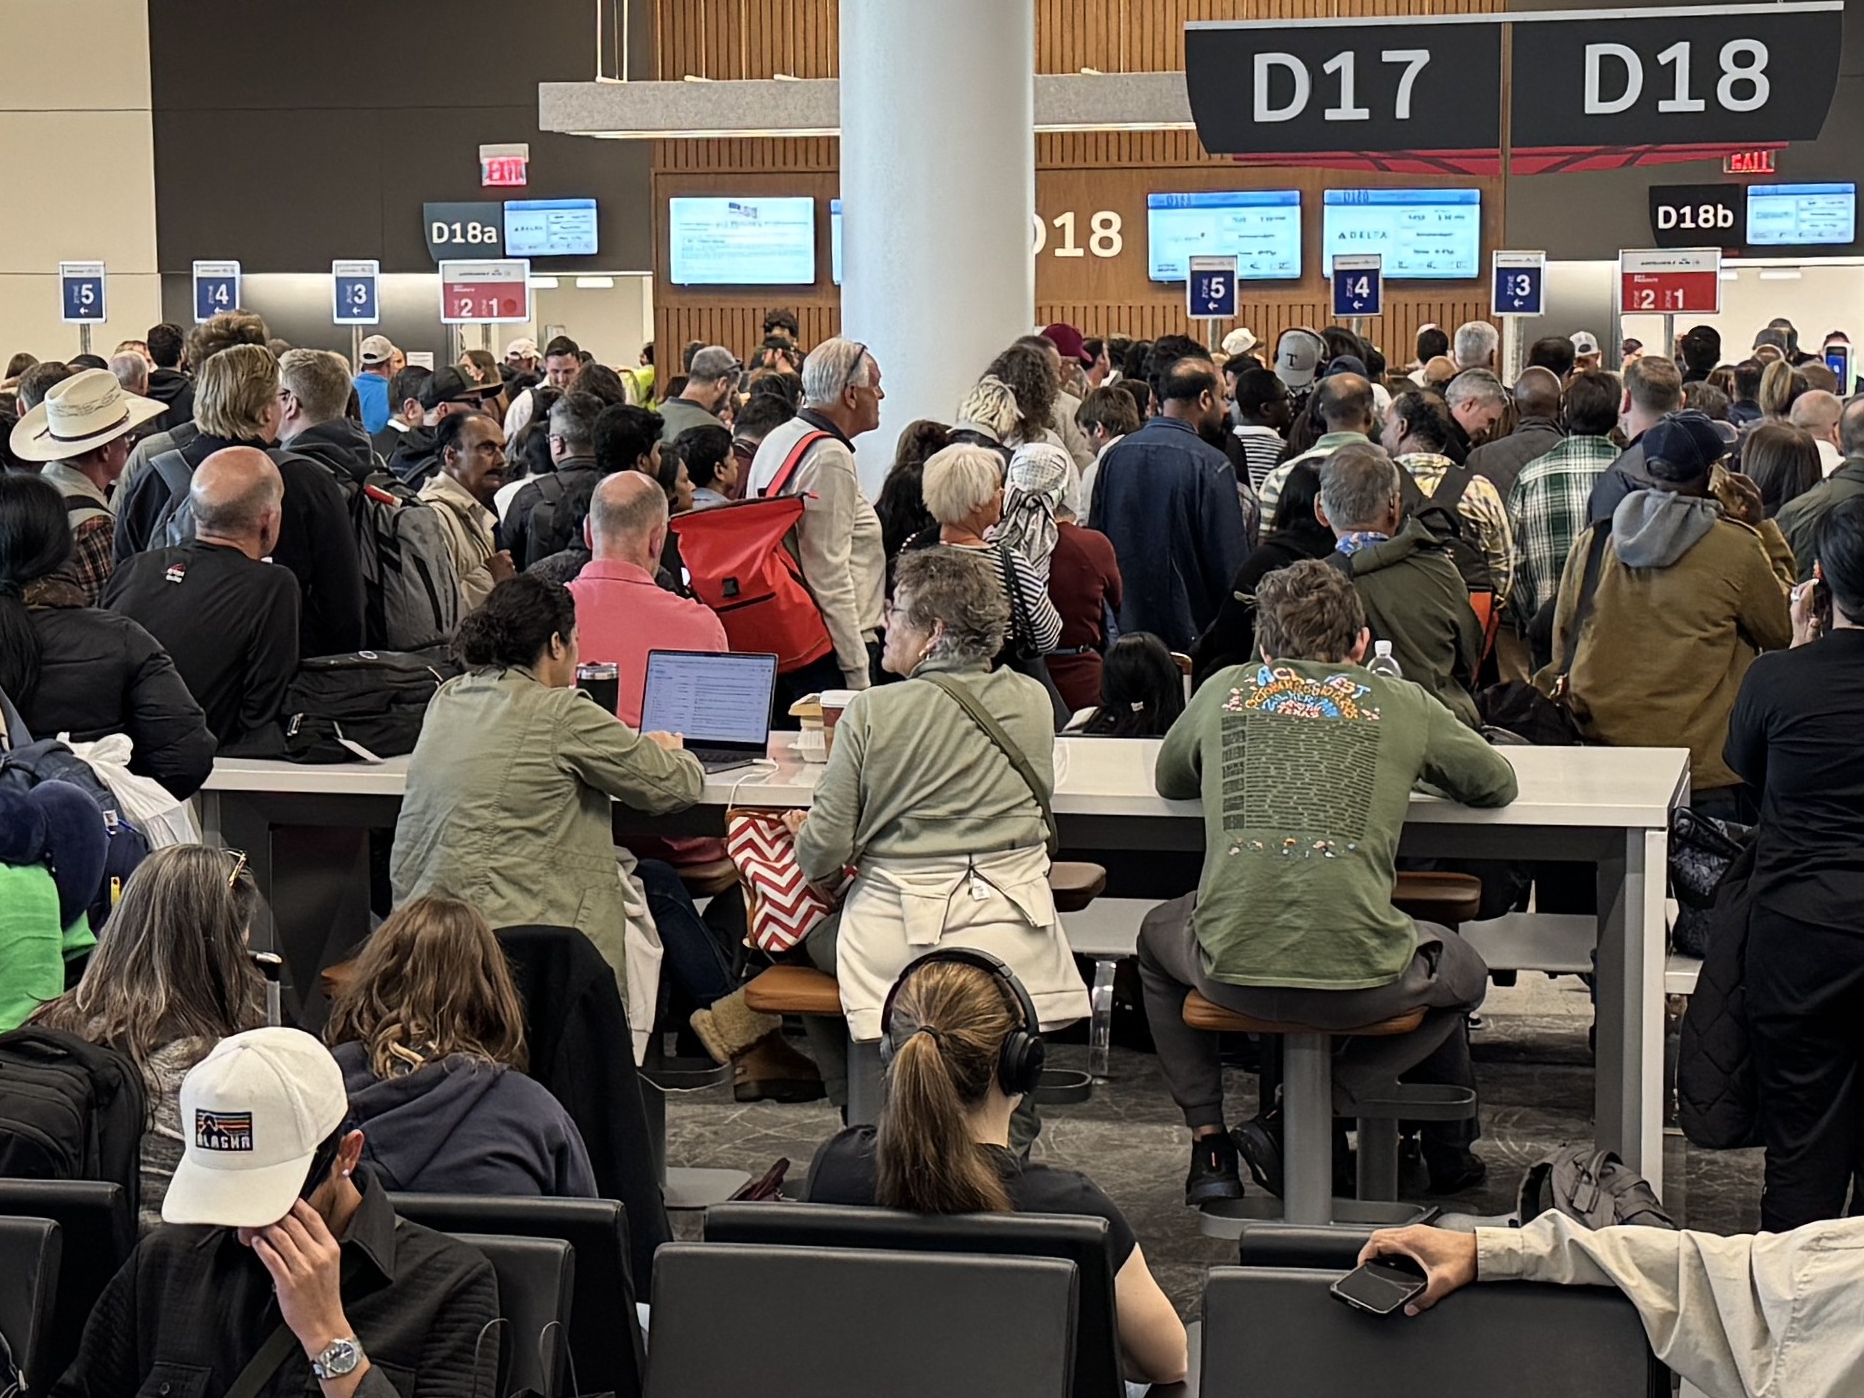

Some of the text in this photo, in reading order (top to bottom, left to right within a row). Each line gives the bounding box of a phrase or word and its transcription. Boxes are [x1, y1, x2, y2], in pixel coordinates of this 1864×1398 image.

[1252, 49, 1431, 122] D17
[1584, 39, 1771, 113] D18
[488, 159, 523, 182] EXIT
[1731, 151, 1769, 170] EXIT
[1657, 204, 1734, 229] D18b
[432, 221, 498, 244] D18a
[81, 284, 95, 305] 5
[215, 283, 230, 304] 4
[353, 284, 367, 304] 3
[1210, 277, 1226, 299] 5
[1354, 276, 1370, 298] 4
[1515, 274, 1531, 296] 3
[460, 298, 473, 316] 2
[488, 298, 498, 316] 1
[1641, 289, 1655, 309] 2
[1673, 288, 1684, 309] 1
[197, 1133, 251, 1150] ALASKA
